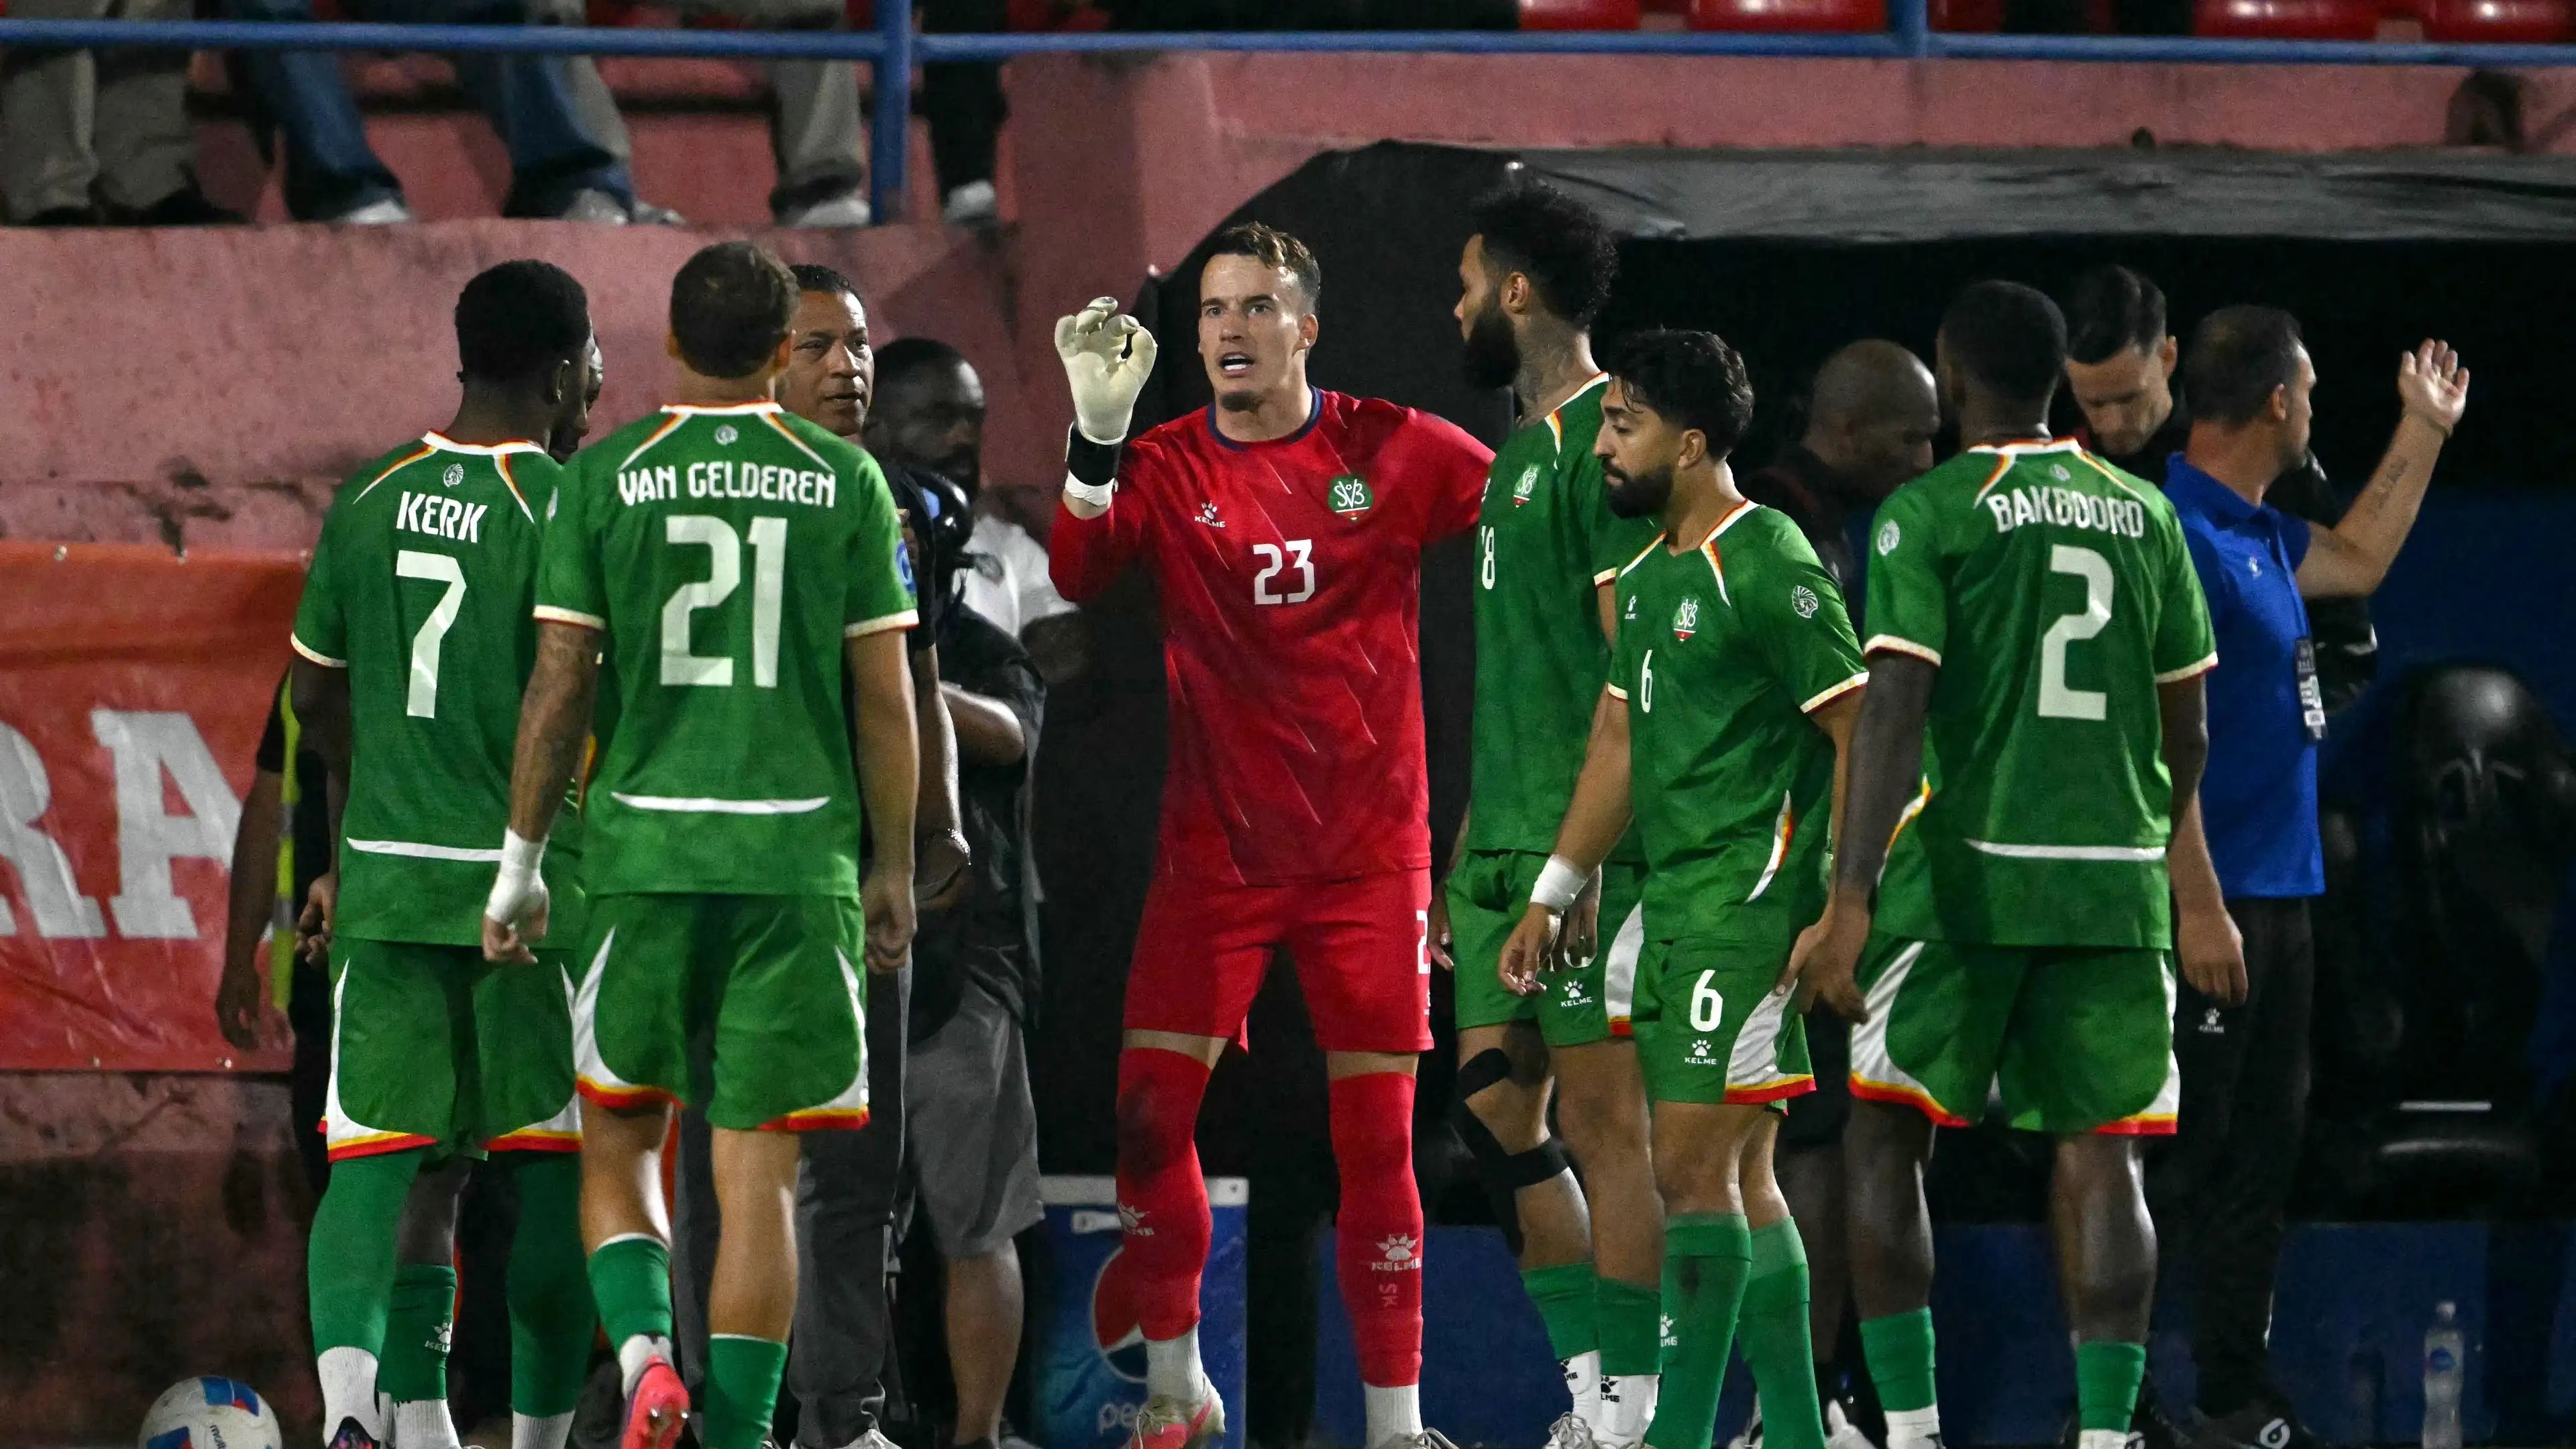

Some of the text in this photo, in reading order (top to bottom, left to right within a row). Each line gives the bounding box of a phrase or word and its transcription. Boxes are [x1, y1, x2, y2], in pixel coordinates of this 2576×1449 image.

[618, 462, 836, 508] VAN GELDEREN
[1334, 479, 1364, 508] SVB
[396, 491, 488, 543] KERK
[1195, 515, 1226, 528] KELME
[1987, 486, 2143, 538] BAKBOORD
[1253, 539, 1316, 604] 23
[660, 515, 788, 688] 21
[396, 550, 466, 719] 7
[2038, 544, 2114, 721] 2
[1641, 649, 1653, 713] 6
[1561, 996, 1593, 1007] KELME
[1690, 969, 1723, 1032] 6
[1684, 1057, 1717, 1065] KELME
[1601, 1393, 1620, 1403] LME
